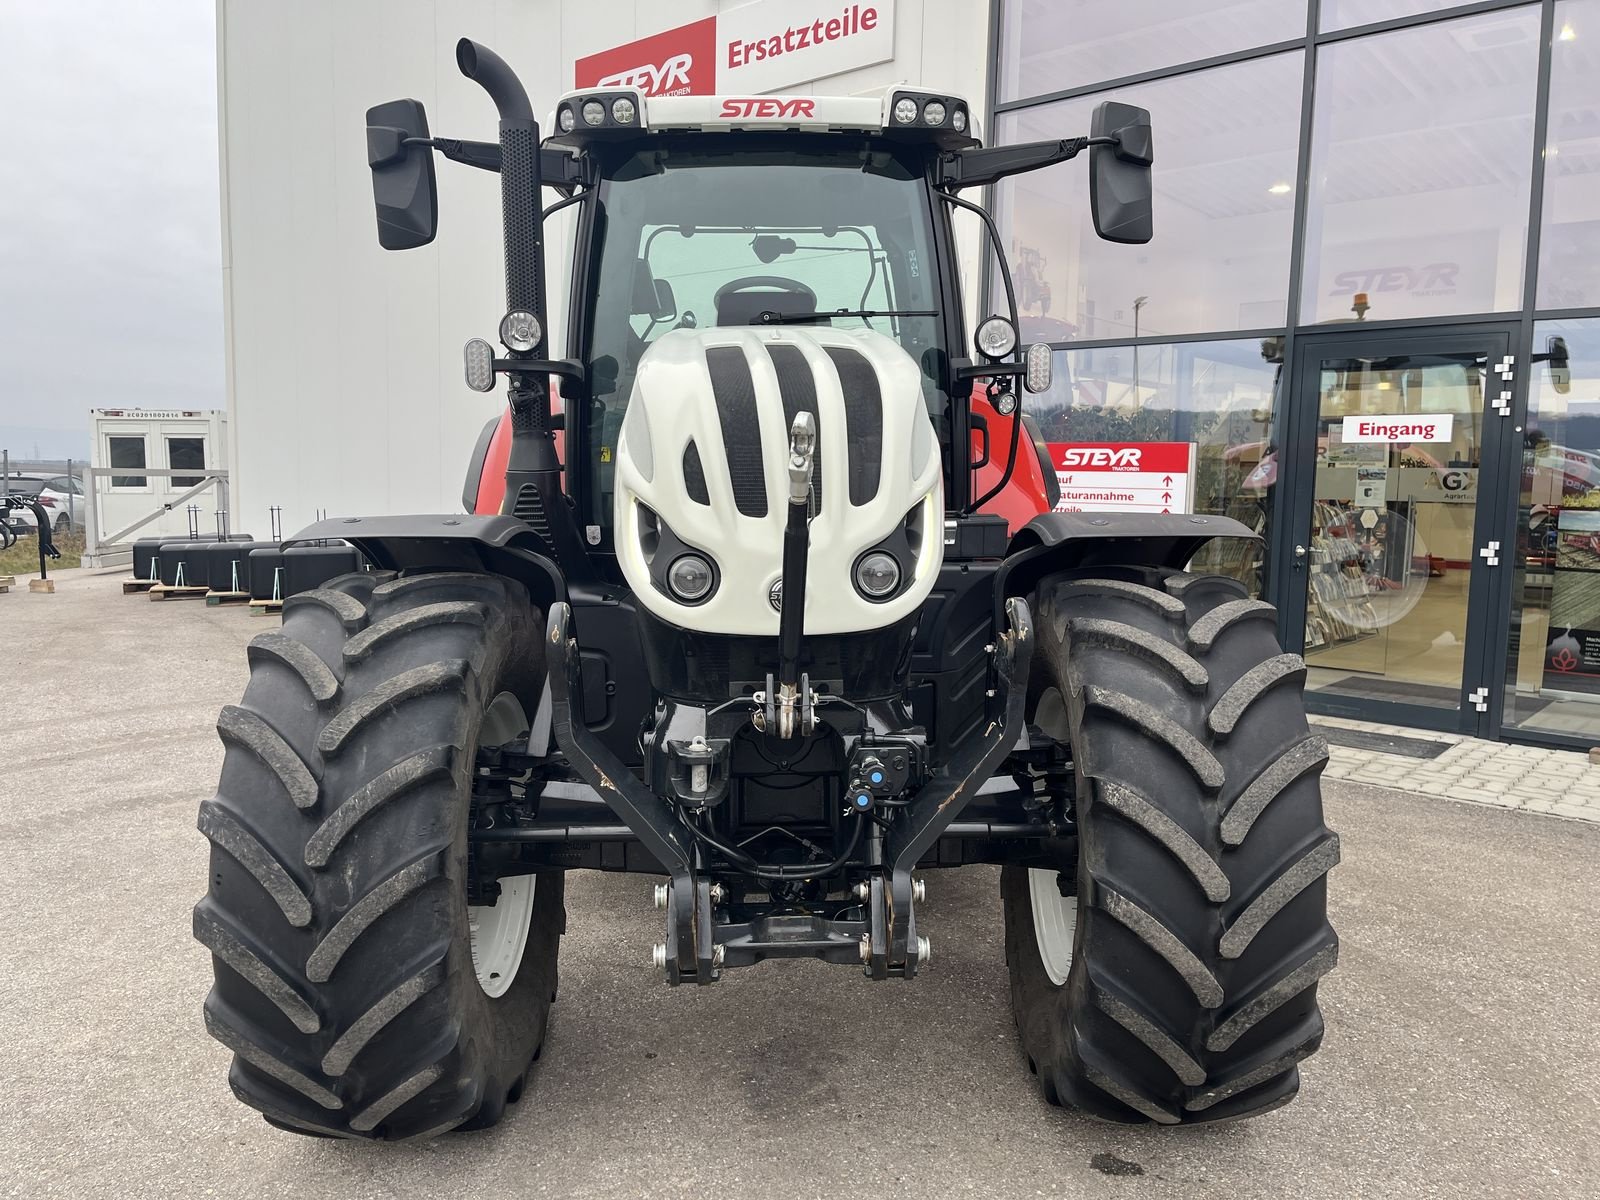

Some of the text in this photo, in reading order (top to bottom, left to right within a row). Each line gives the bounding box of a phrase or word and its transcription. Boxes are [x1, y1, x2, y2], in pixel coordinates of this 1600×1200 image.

[728, 4, 878, 69] Ersatzteile
[719, 98, 815, 118] STEYR
[1328, 262, 1459, 297] STEYR
[1358, 422, 1436, 440] Eingang
[1061, 447, 1142, 467] STEYR
[1057, 475, 1073, 484] auf
[1060, 491, 1135, 501] aturannahme
[1053, 505, 1082, 513] zteile
